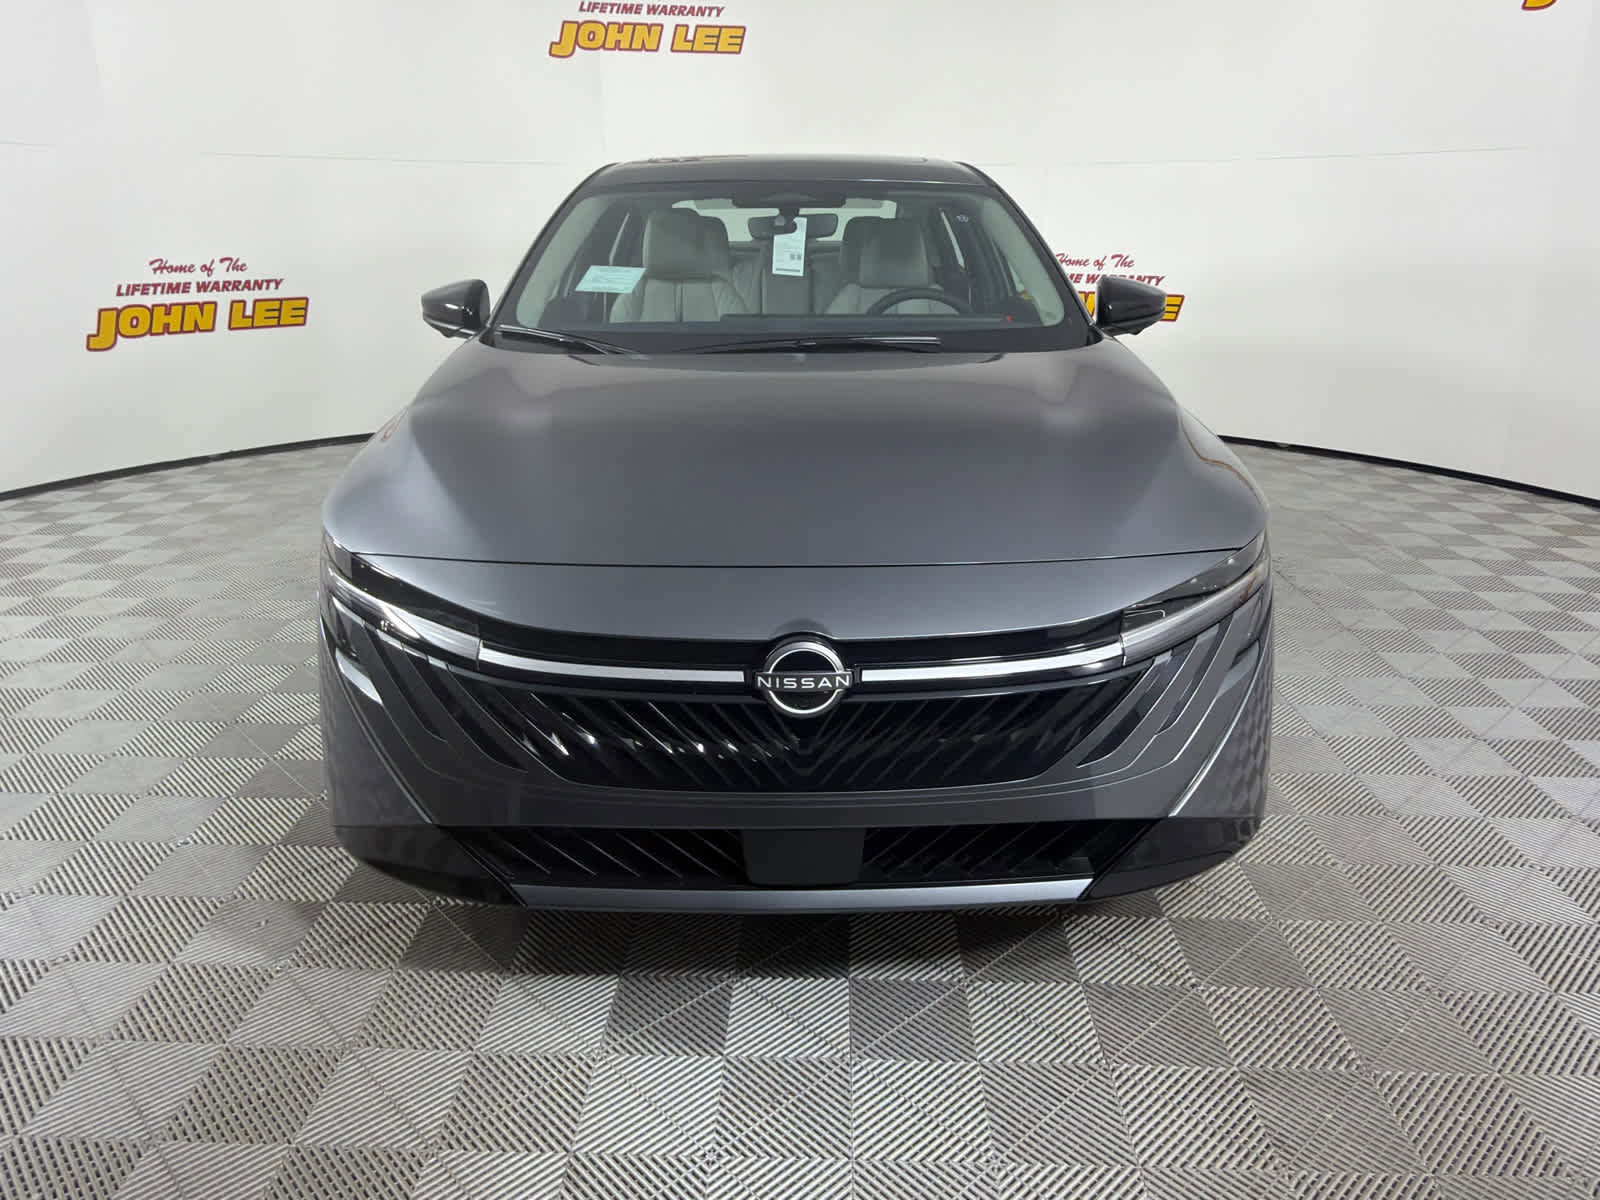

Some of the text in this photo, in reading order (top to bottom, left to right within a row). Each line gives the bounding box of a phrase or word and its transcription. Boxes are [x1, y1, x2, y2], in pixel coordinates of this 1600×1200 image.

[578, 1, 724, 17] LIFETIME WARRANTY
[549, 20, 746, 58] JOHN LEE
[149, 257, 248, 277] Home of The
[1093, 255, 1107, 271] of
[1111, 254, 1135, 268] The
[116, 278, 284, 297] LIFETIME WARRANTY
[86, 297, 309, 352] JOHN LEE
[757, 675, 850, 689] NISSAN
